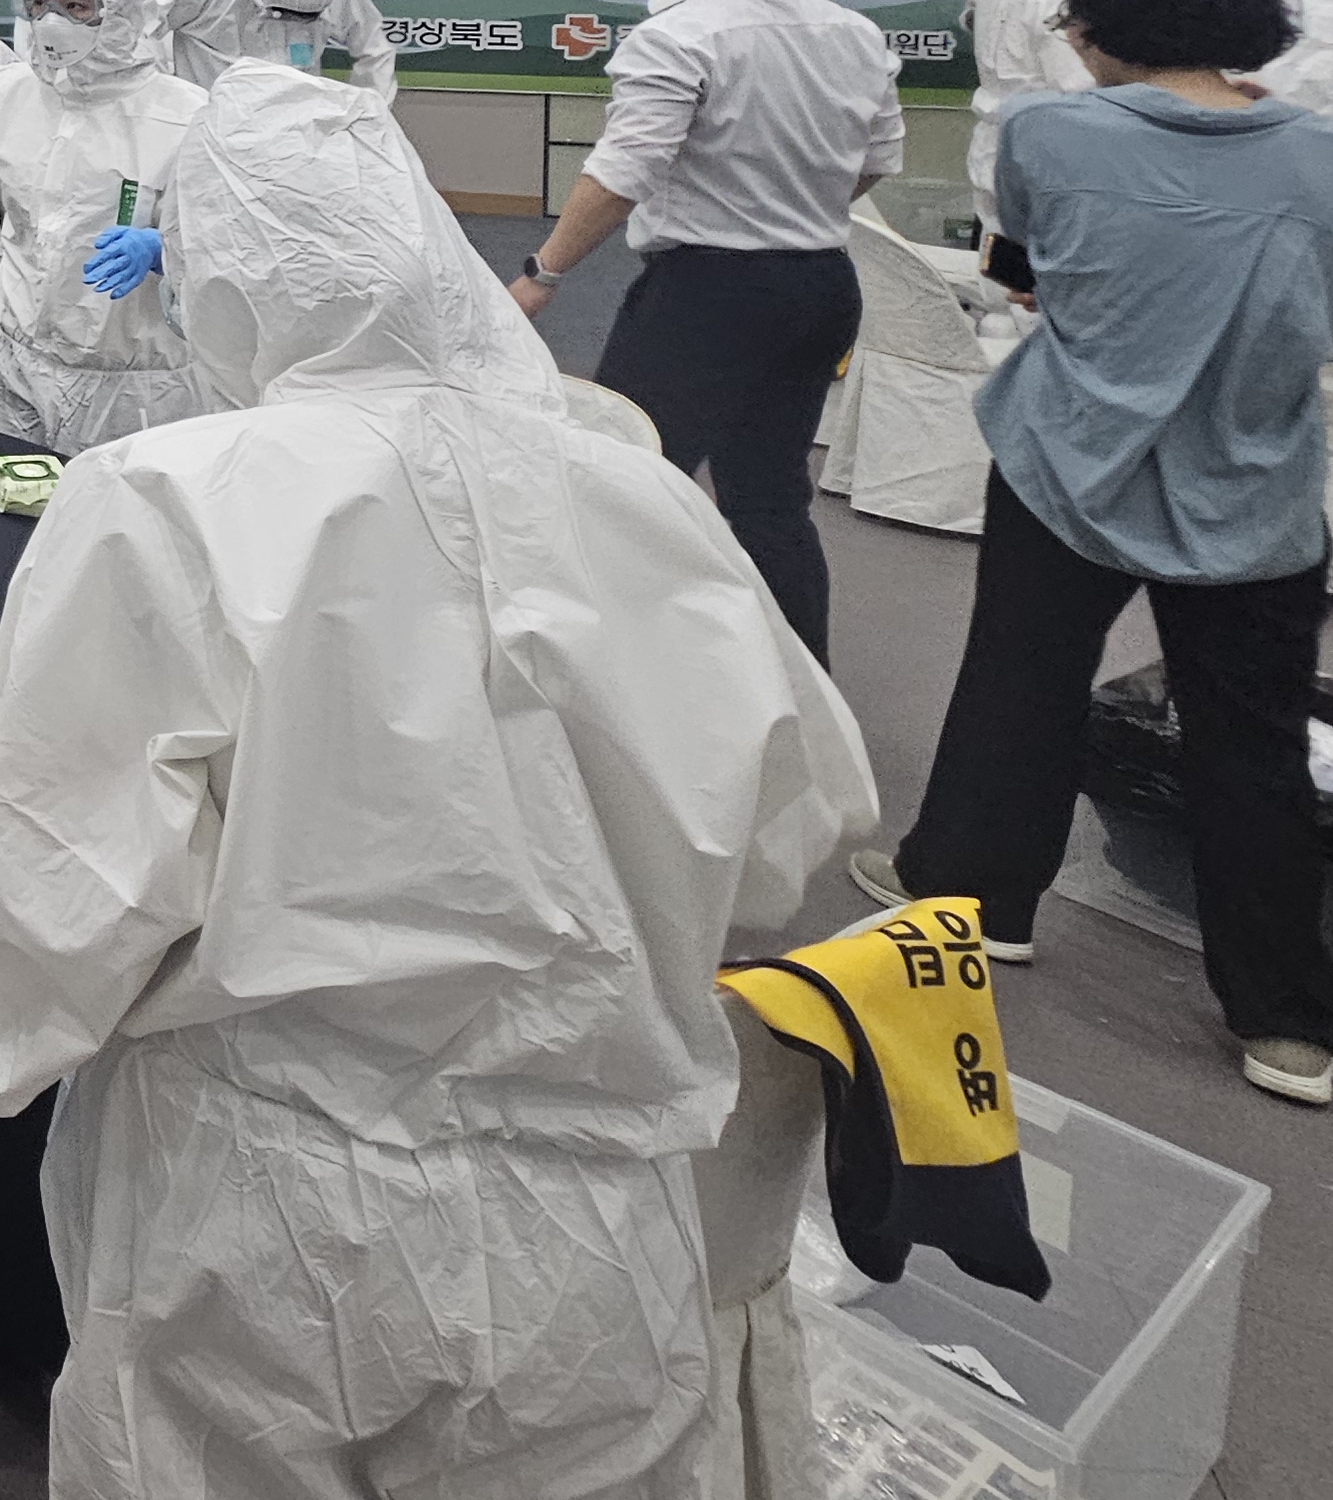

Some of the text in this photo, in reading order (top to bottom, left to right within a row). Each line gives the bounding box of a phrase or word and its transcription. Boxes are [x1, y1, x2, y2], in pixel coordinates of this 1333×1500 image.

[383, 20, 519, 48] 경상북도
[886, 32, 951, 57] 원단
[879, 910, 986, 990] 응팀
